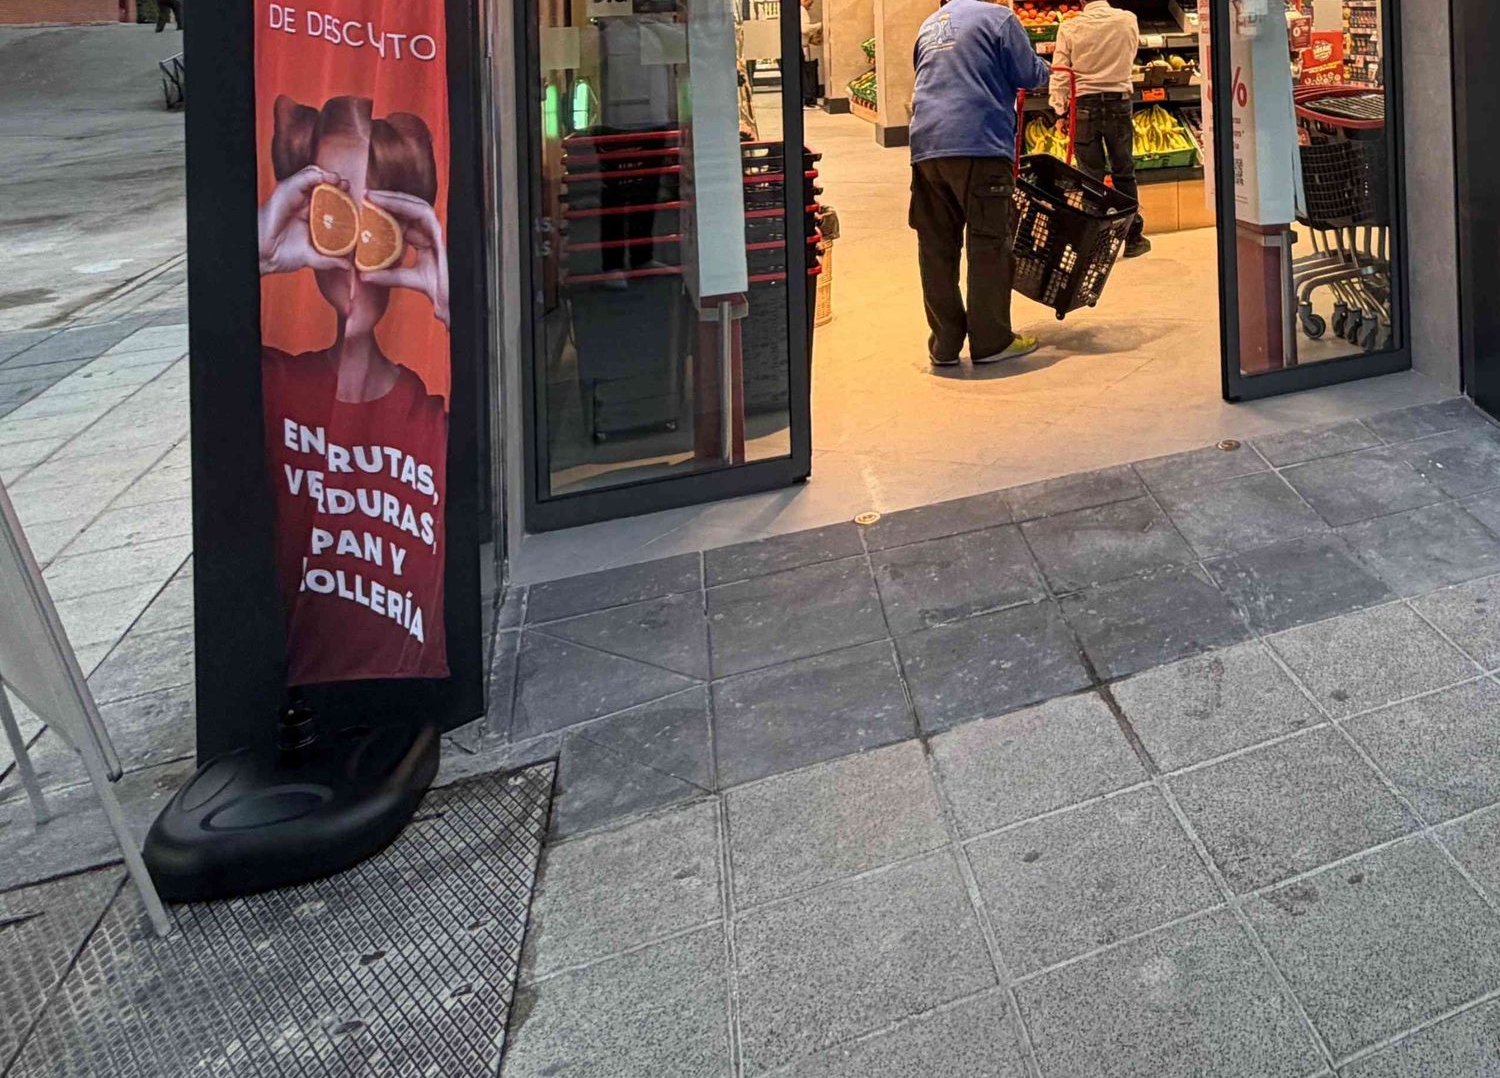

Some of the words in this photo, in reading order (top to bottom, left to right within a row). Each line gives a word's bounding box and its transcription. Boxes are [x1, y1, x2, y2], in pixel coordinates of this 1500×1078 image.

[269, 3, 297, 33] DE
[284, 418, 325, 455] EN
[325, 443, 439, 506] RUTAS,
[311, 527, 383, 567] PAN
[389, 542, 407, 576] Y
[300, 557, 425, 643] OLLERÍA
